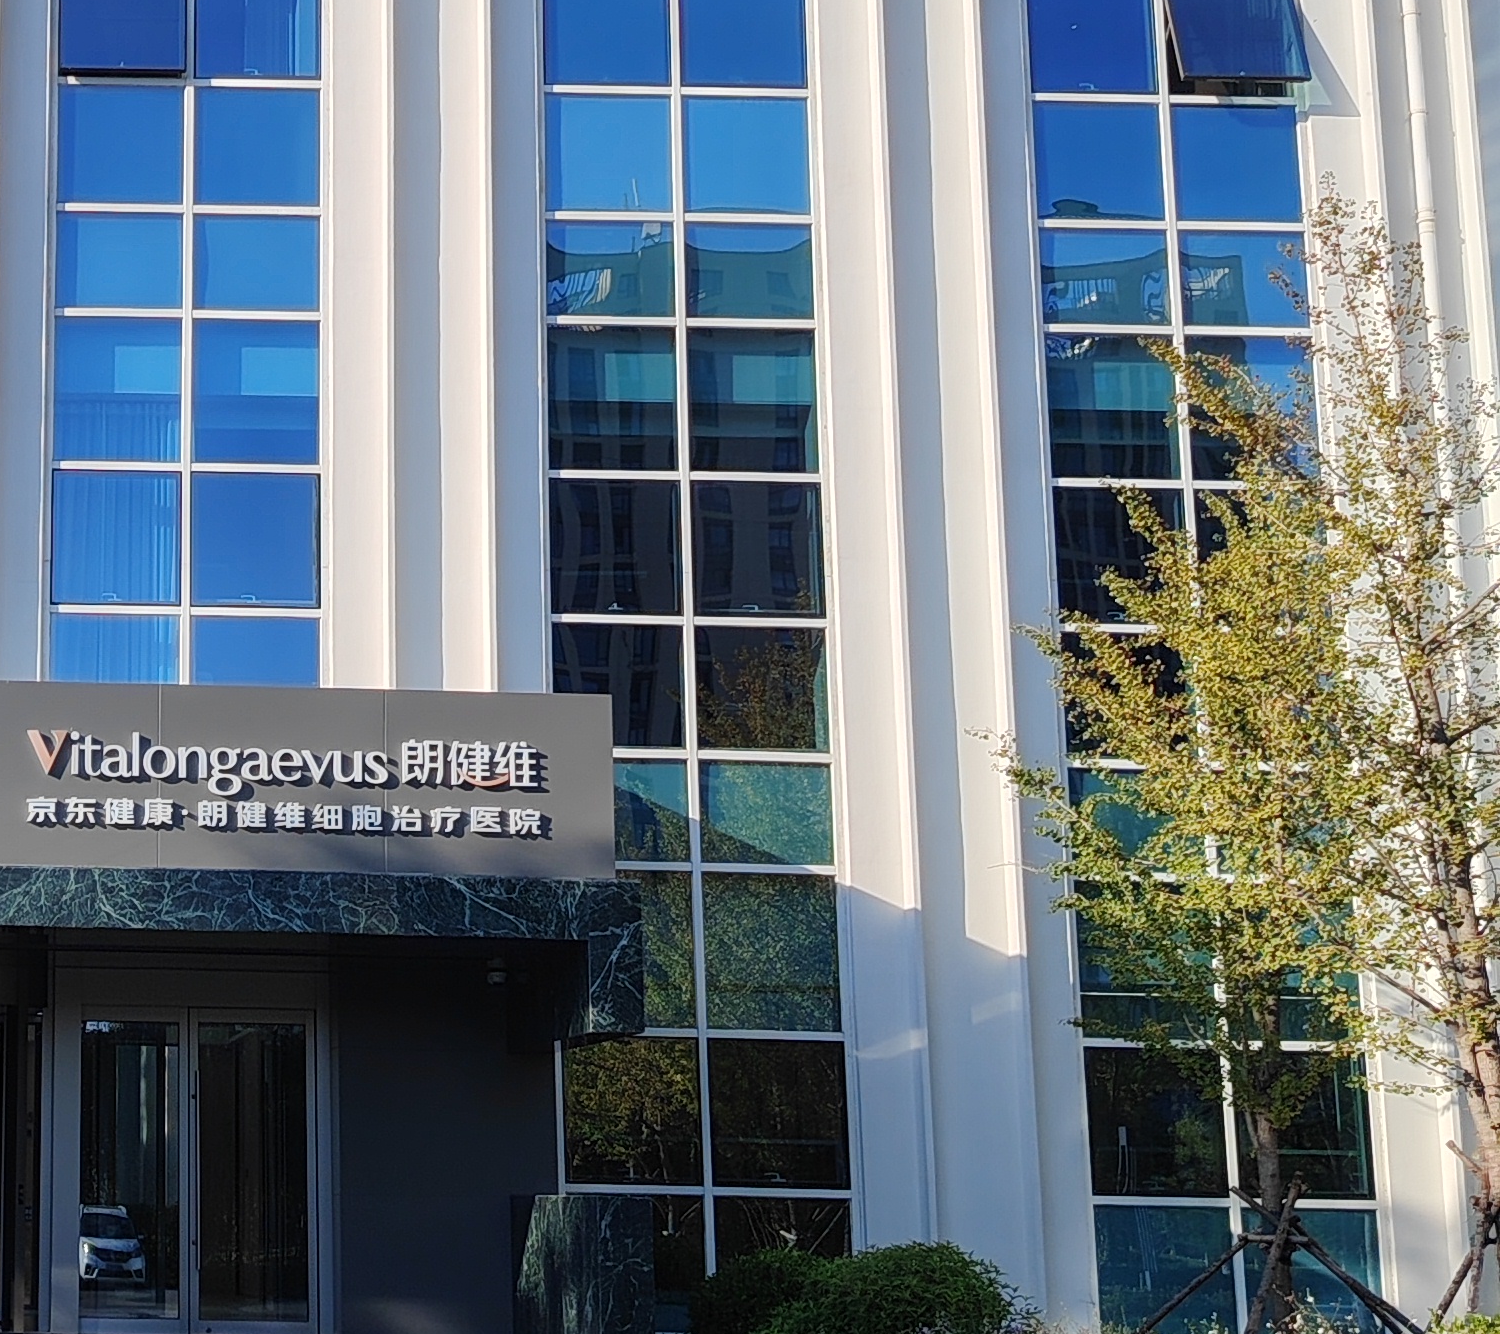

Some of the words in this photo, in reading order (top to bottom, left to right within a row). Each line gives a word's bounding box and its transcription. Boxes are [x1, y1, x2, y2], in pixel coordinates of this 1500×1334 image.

[26, 729, 388, 795] Vitalongaevus
[401, 738, 539, 788] 朗健维
